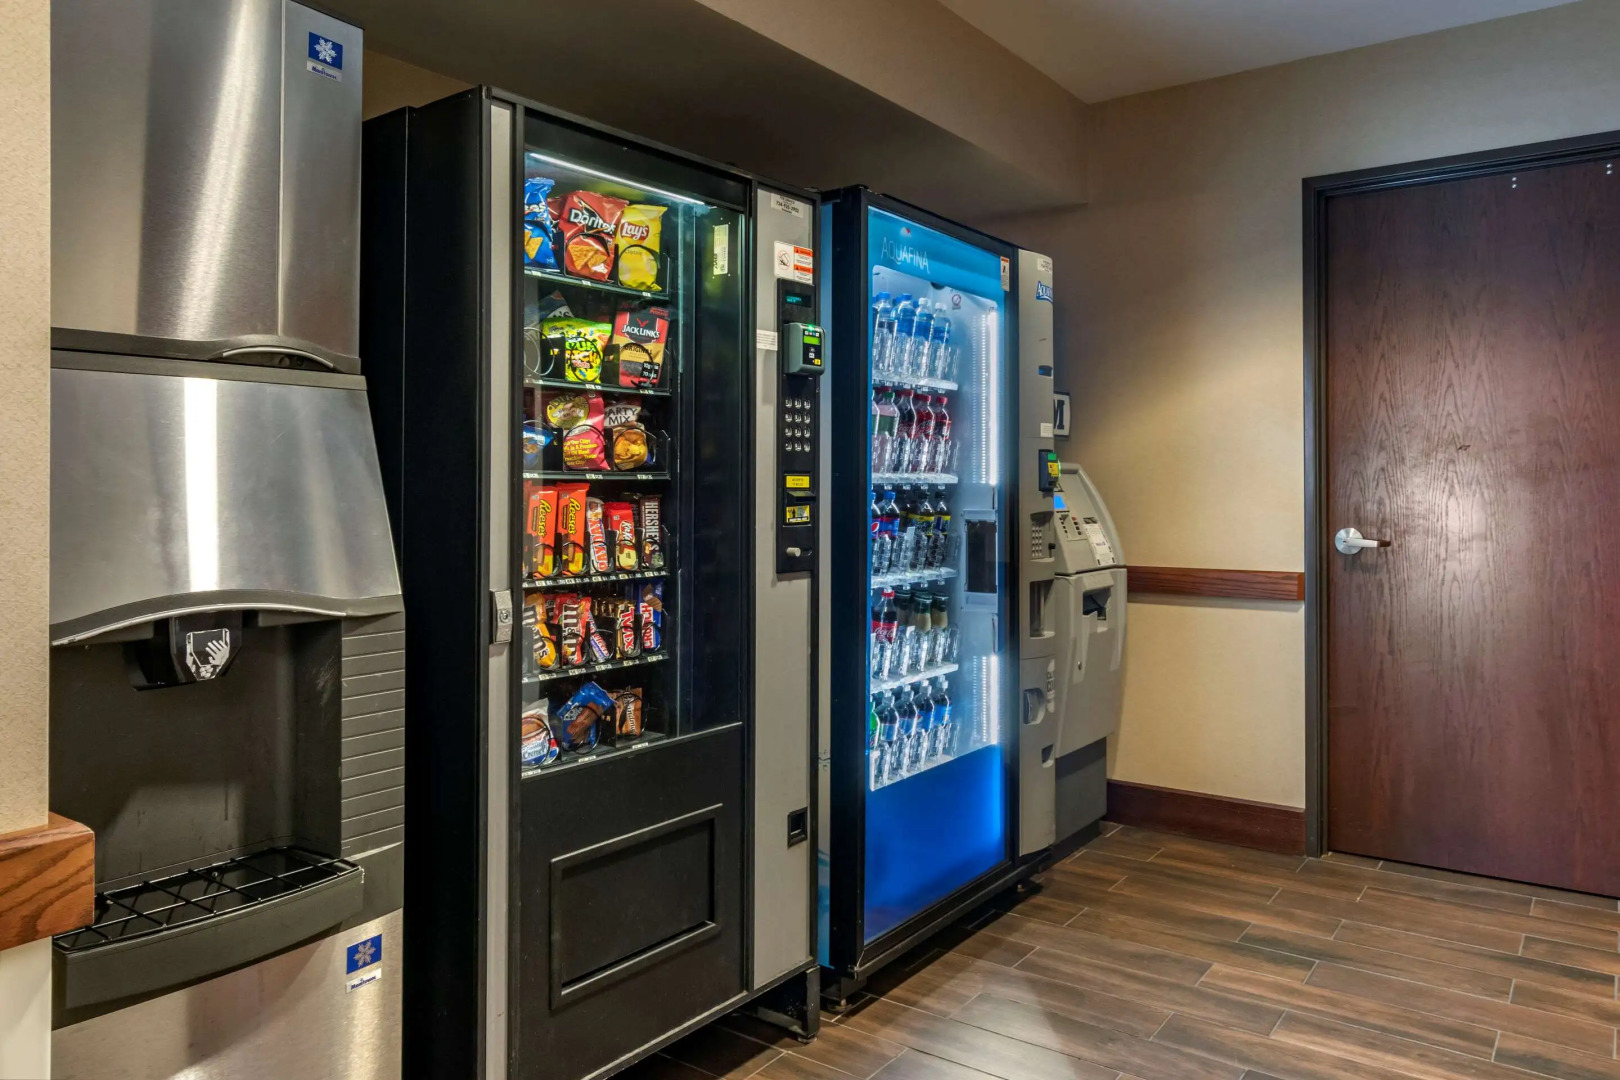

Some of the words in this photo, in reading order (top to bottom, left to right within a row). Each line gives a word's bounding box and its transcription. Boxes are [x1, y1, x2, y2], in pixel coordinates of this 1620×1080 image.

[569, 208, 617, 234] Doritos
[622, 221, 649, 240] Lay's
[880, 236, 931, 275] AQUAFINA
[622, 324, 640, 335] JACK
[639, 328, 660, 339] LINK'S
[624, 345, 652, 356] ORIGINL
[608, 415, 631, 427] MIX
[538, 499, 552, 536] Reese's
[567, 497, 581, 534] Reese's
[621, 607, 634, 651] TWIX
